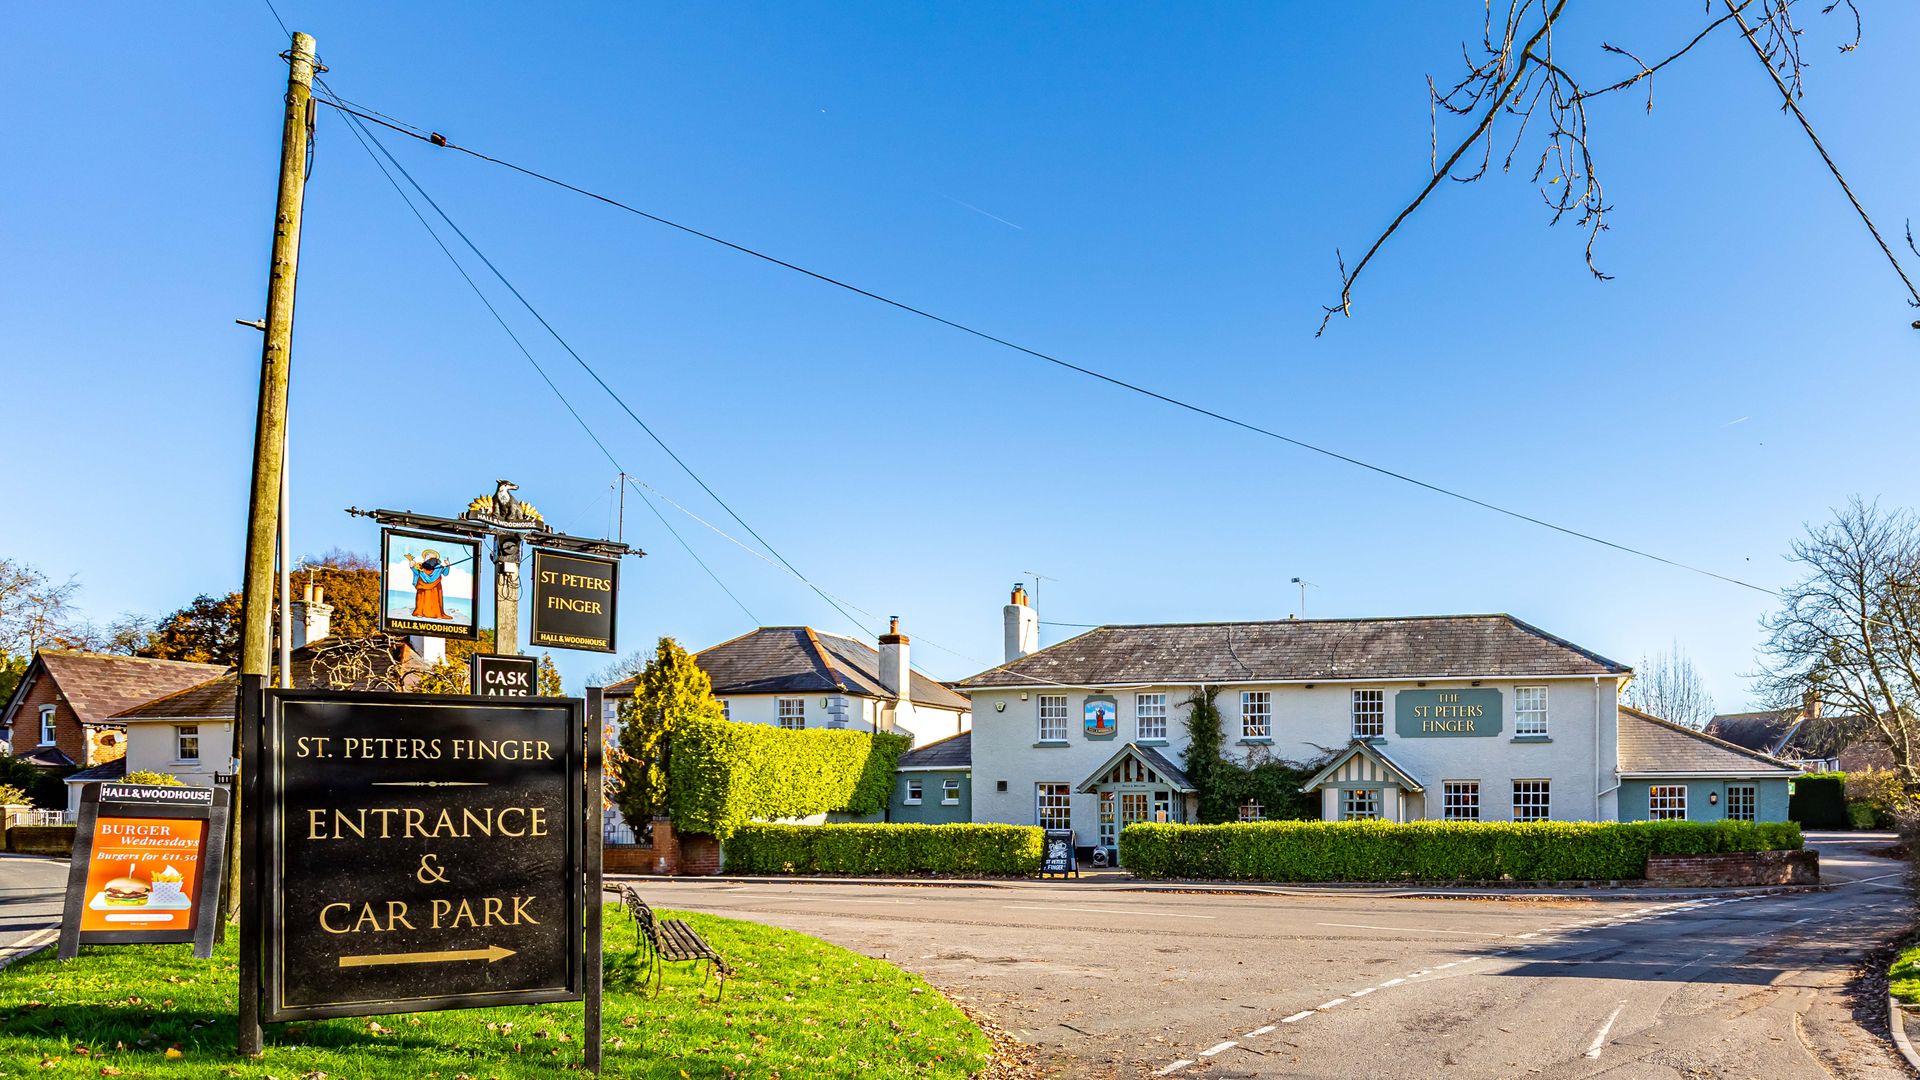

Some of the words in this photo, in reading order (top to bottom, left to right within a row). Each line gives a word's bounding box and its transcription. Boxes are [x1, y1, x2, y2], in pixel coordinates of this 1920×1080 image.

[541, 570, 559, 585] ST
[562, 573, 611, 592] PETERS
[548, 596, 602, 615] FINGER
[485, 670, 529, 688] CASK
[1439, 693, 1460, 703] THE
[1414, 704, 1431, 718] ST
[1435, 704, 1483, 718] PETERS
[1423, 720, 1475, 732] FINGER
[296, 736, 333, 759] ST.
[343, 737, 442, 760] PETERS
[452, 739, 555, 761] FINGER
[101, 824, 171, 836] BURGER
[306, 806, 548, 840] ENTRANCE
[121, 836, 200, 848] Wednesdays
[96, 851, 140, 861] Burgers
[141, 852, 159, 862] for
[161, 853, 198, 861] £11.50
[416, 853, 450, 884] &
[319, 900, 417, 934] CAR
[430, 895, 541, 930] PARK
